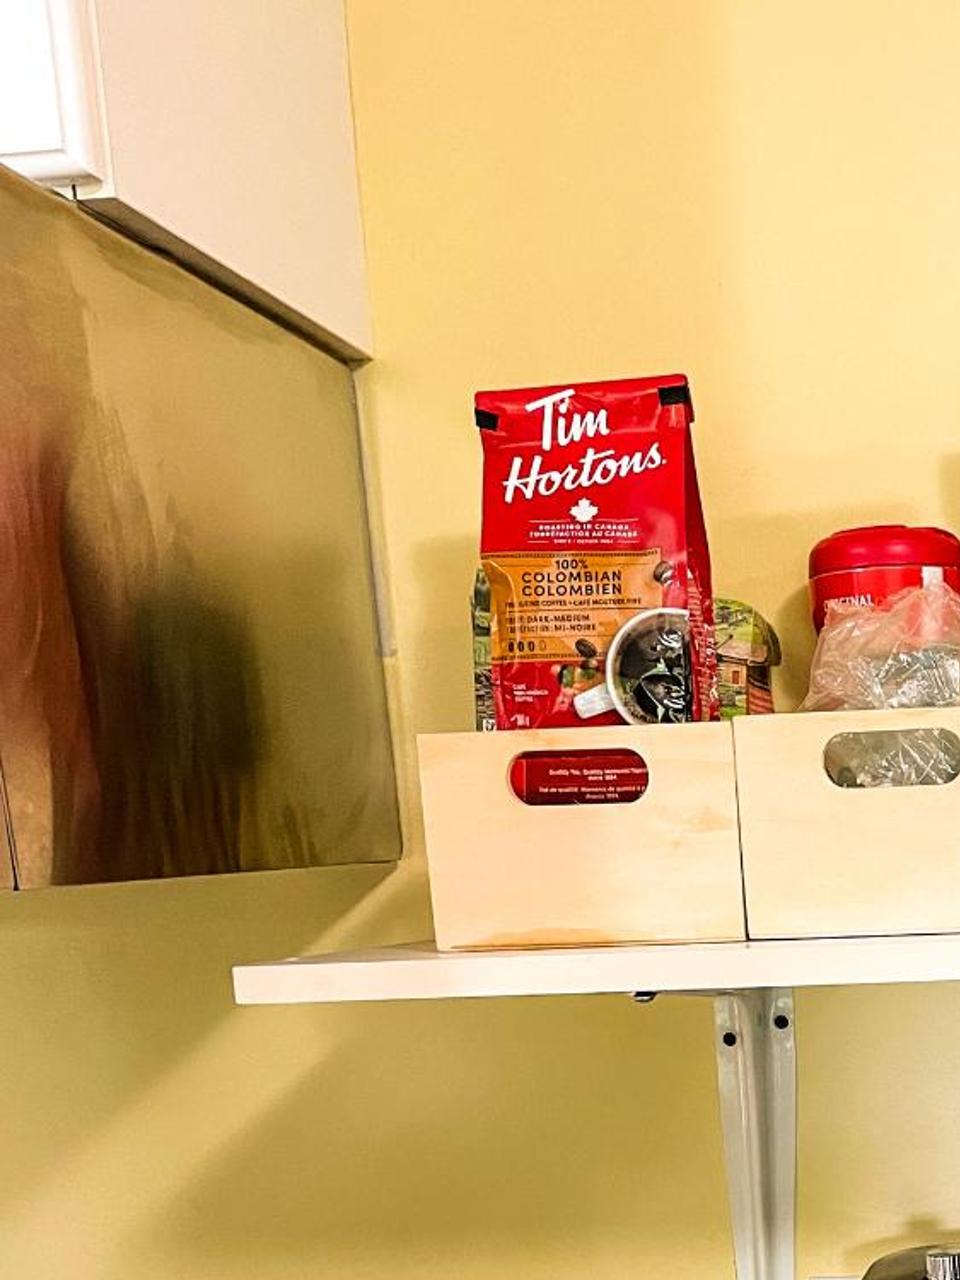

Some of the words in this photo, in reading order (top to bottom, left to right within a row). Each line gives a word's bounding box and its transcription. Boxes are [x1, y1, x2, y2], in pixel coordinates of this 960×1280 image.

[525, 388, 610, 451] Tim
[554, 559, 589, 571] 100%
[521, 570, 623, 584] COLOMBIAN
[521, 583, 623, 597] COLOMBIEN
